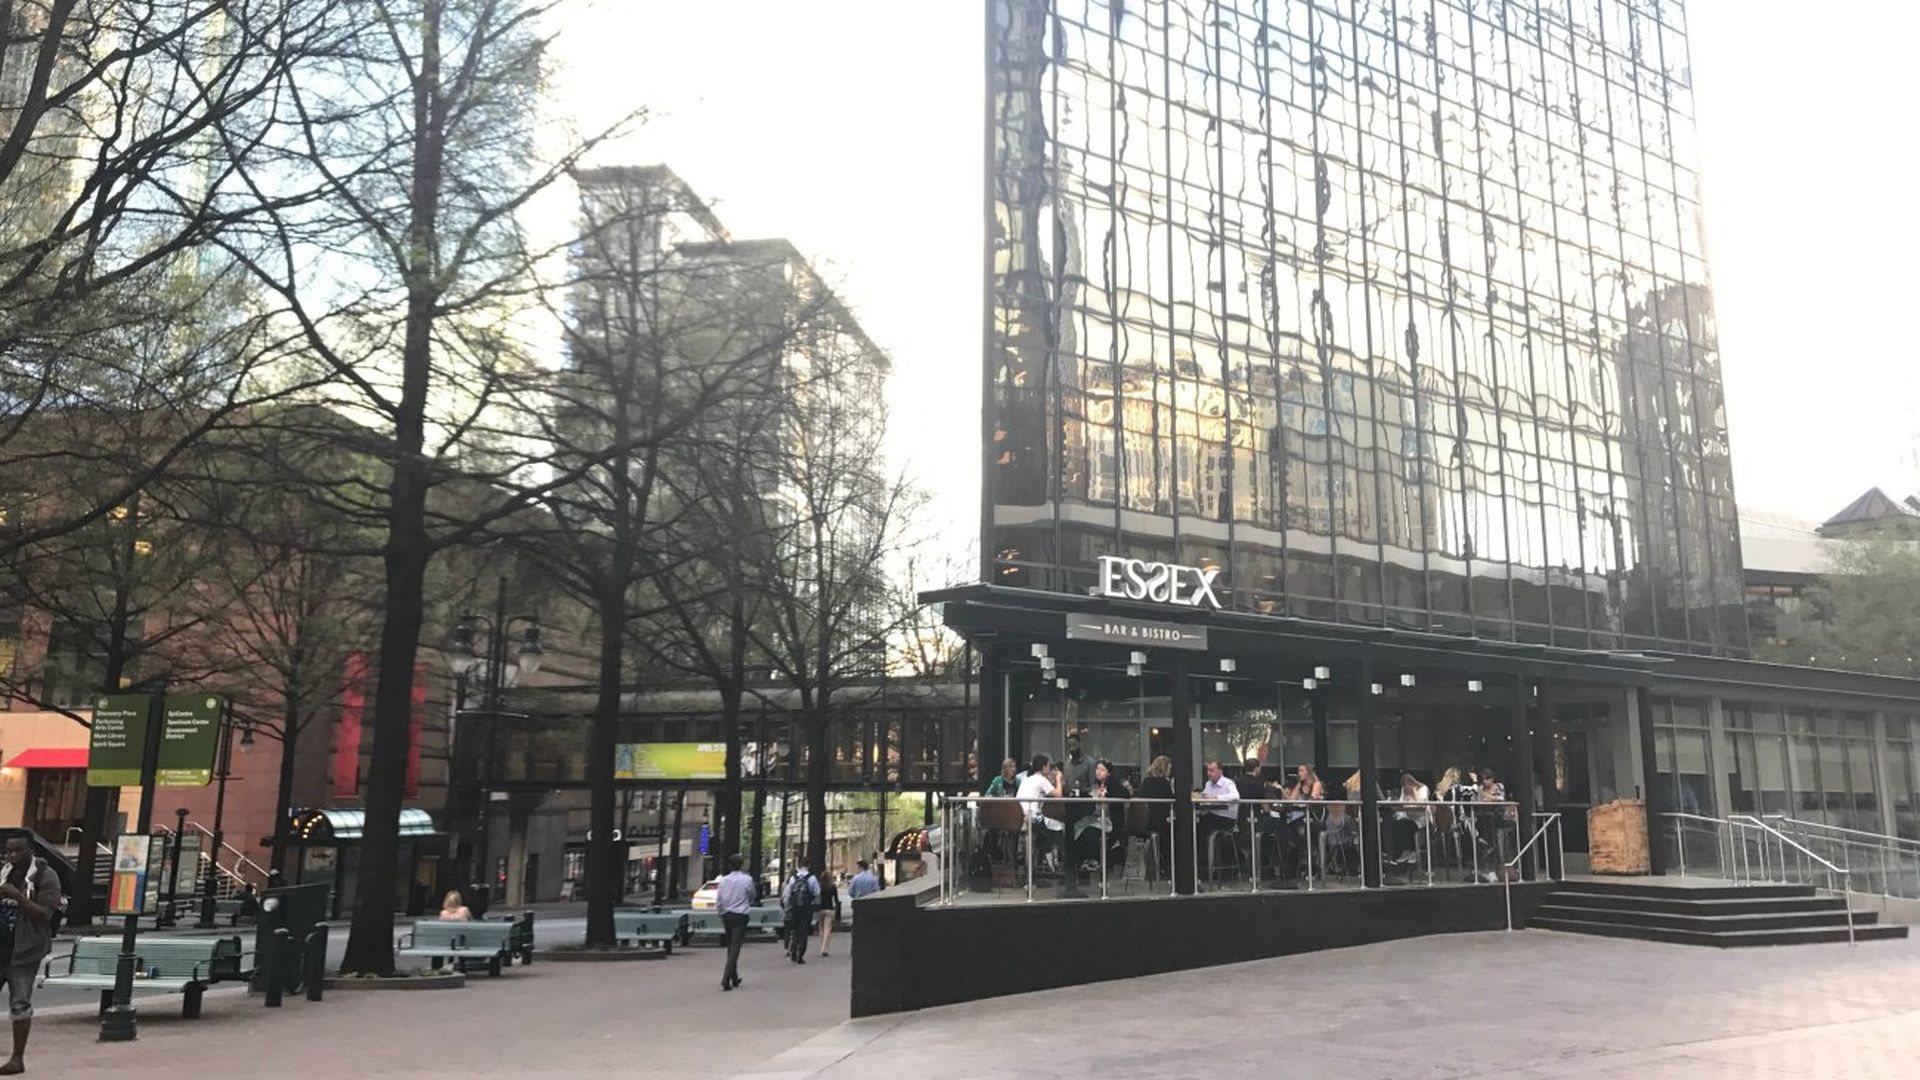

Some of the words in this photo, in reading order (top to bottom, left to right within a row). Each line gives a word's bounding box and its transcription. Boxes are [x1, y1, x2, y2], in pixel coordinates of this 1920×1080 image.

[1098, 555, 1223, 609] ESSEX
[1104, 624, 1127, 635] BAR
[1131, 626, 1138, 637] &
[1142, 627, 1180, 641] BISTRO
